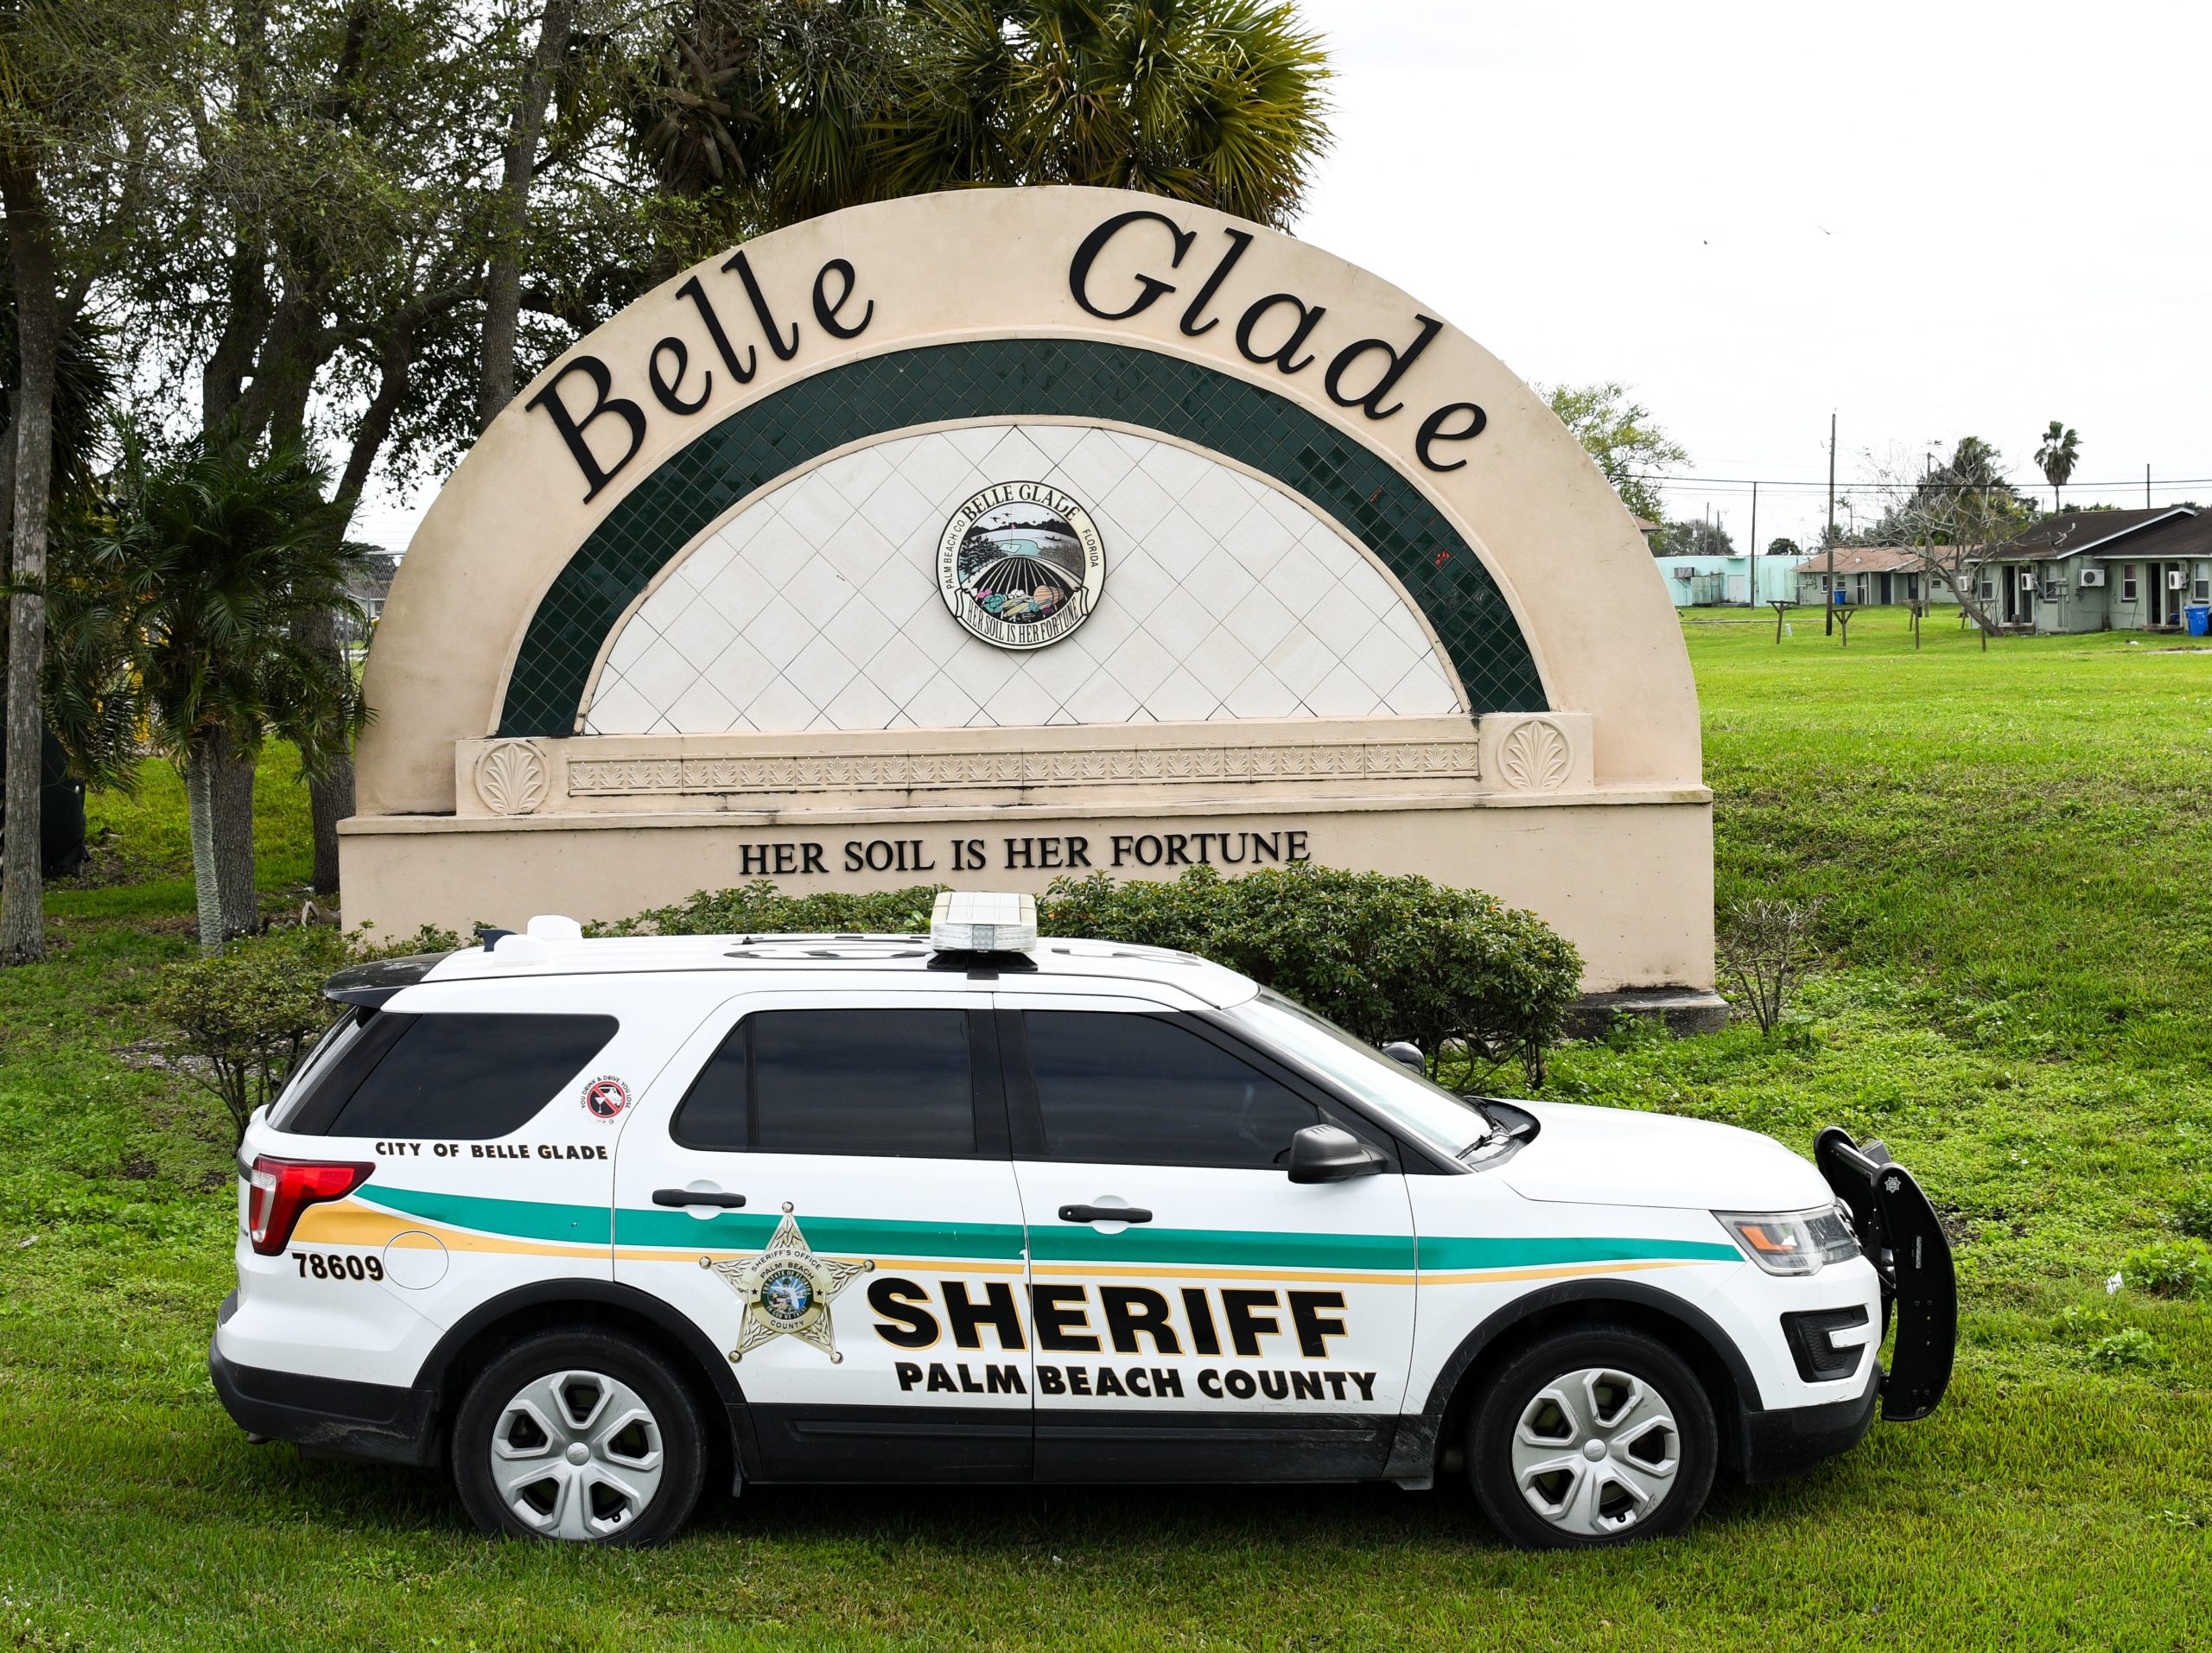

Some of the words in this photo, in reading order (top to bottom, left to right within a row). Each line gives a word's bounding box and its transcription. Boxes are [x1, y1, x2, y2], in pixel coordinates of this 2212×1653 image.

[524, 249, 874, 505] Belle
[1069, 210, 1488, 473] Glade
[961, 485, 1014, 523] BELLE
[954, 519, 967, 533] CO.
[944, 533, 957, 565] BEACH
[1082, 528, 1099, 568] FLORIDA
[944, 567, 955, 589] PALM
[967, 598, 983, 632] HER
[985, 616, 1004, 640] SOIL
[1007, 624, 1016, 642] IS
[1019, 624, 1039, 643] HER
[739, 842, 830, 875] HER
[844, 839, 936, 872] SOIL
[950, 839, 987, 871] IS
[1003, 836, 1092, 868] HER
[1110, 830, 1312, 867] FORTUNE
[375, 1141, 422, 1156] CITY
[433, 1143, 460, 1157] OF
[471, 1144, 531, 1159] BELLE
[537, 1145, 608, 1160] GLADE
[291, 1252, 384, 1281] 78609
[751, 1249, 791, 1272] SHERIFF'S
[794, 1250, 822, 1270] OFFICE
[760, 1262, 783, 1279] PALM
[788, 1262, 815, 1280] BEACH
[770, 1319, 804, 1329] COUNTY
[867, 1276, 1350, 1360] SHERIFF
[893, 1362, 1027, 1395] PALM
[1034, 1365, 1185, 1399] BEACH
[1197, 1369, 1378, 1402] COUNTY
